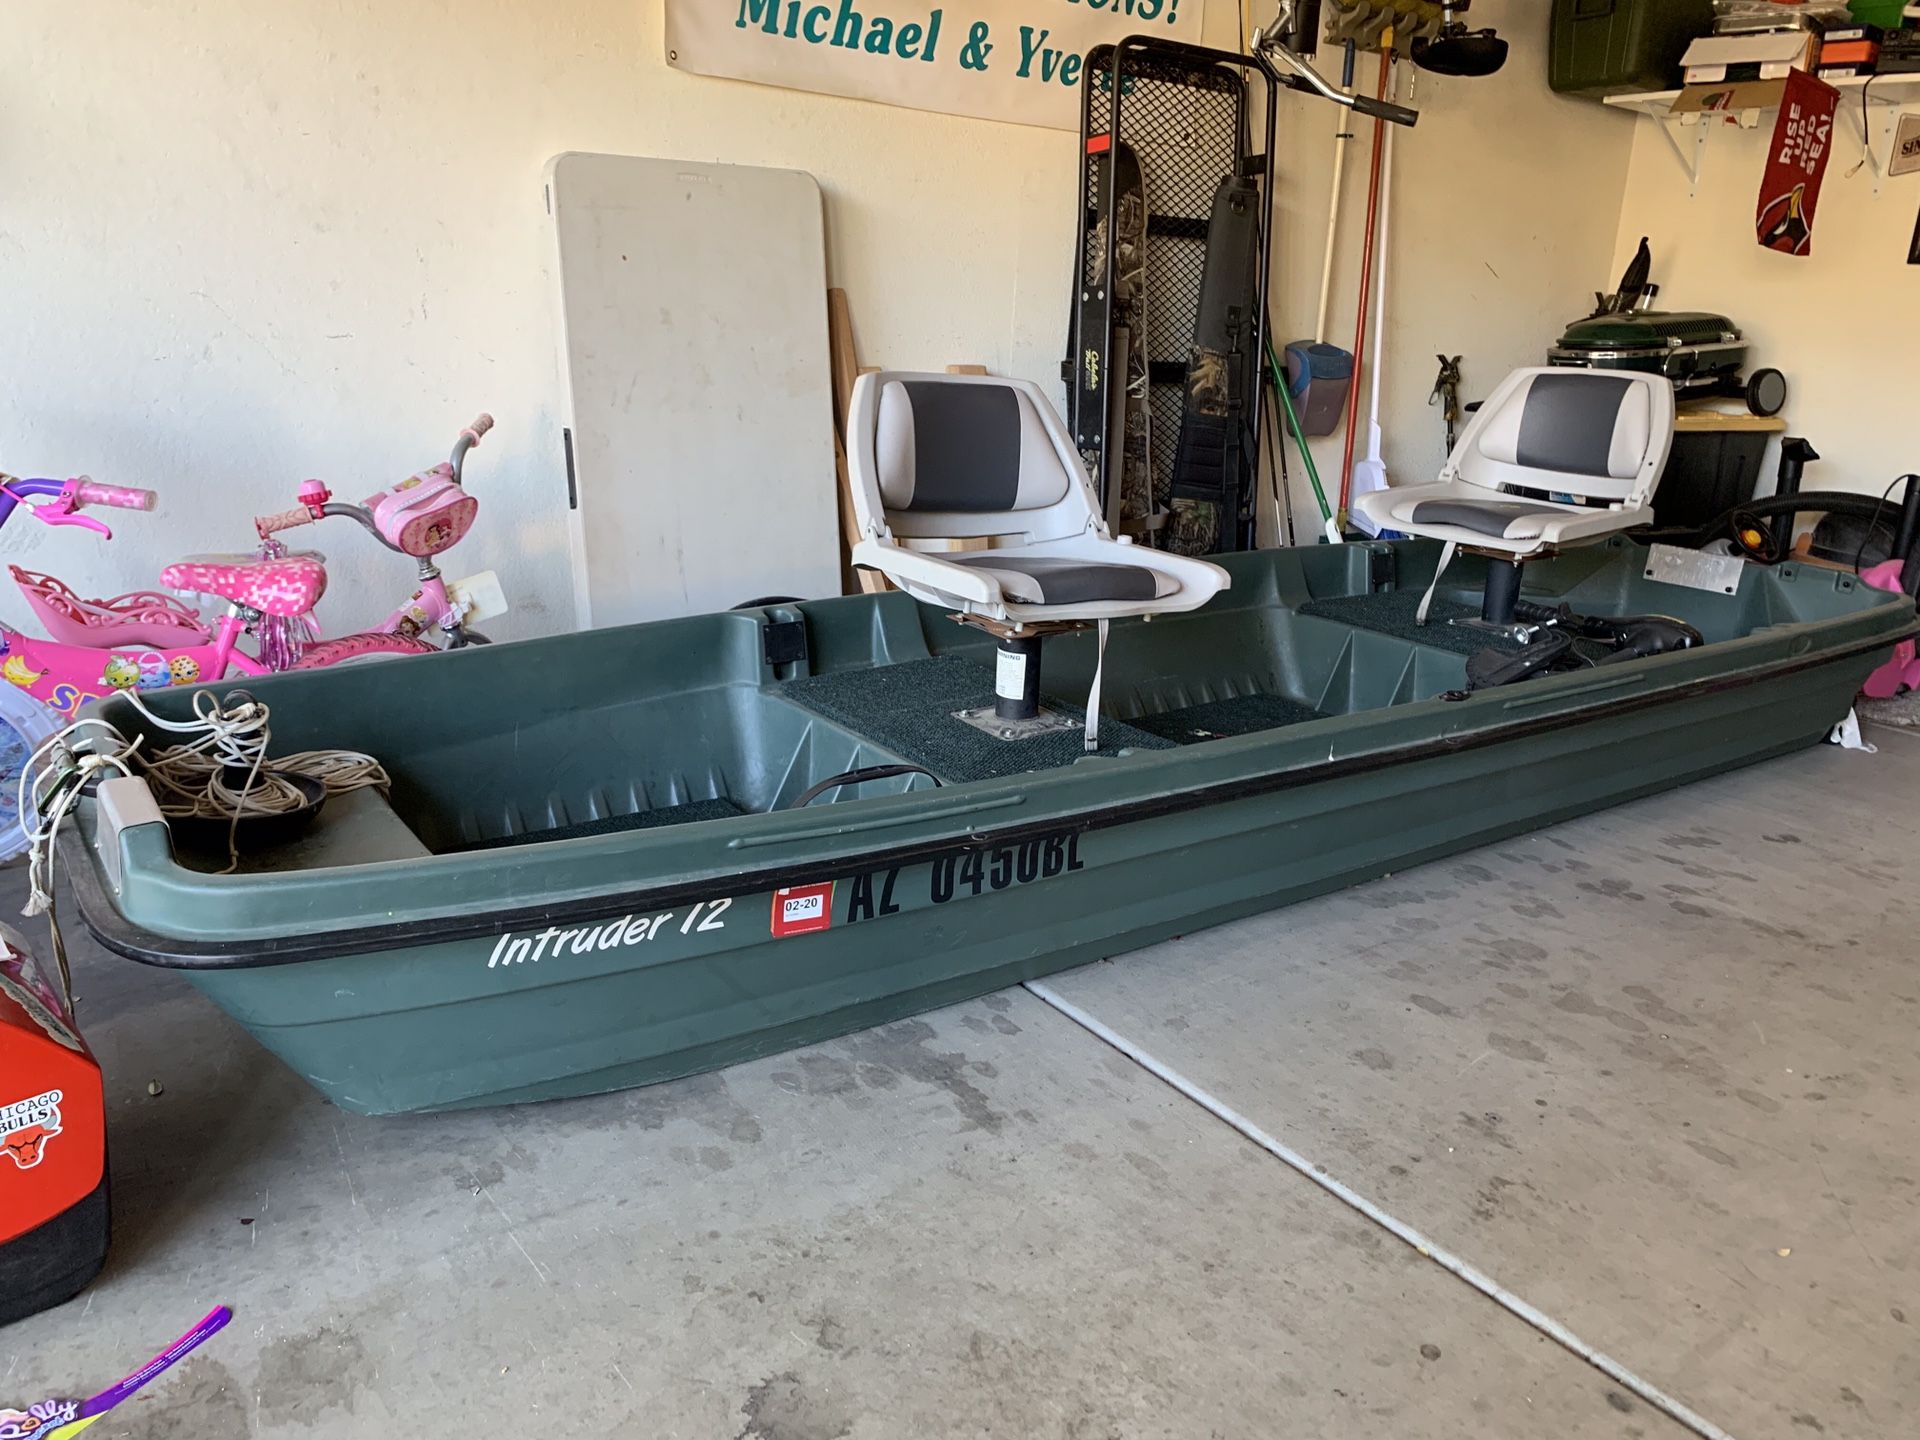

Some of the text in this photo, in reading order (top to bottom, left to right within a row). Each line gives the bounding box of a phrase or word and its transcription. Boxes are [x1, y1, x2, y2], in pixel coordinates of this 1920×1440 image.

[735, 0, 943, 62] Michael
[960, 21, 994, 71] &
[1779, 103, 1801, 165] RISE
[1794, 120, 1806, 156] UP
[1806, 113, 1832, 176] SEA!
[785, 897, 818, 912] 02-20
[847, 867, 900, 923] AZ
[487, 898, 732, 968] Intruder 12
